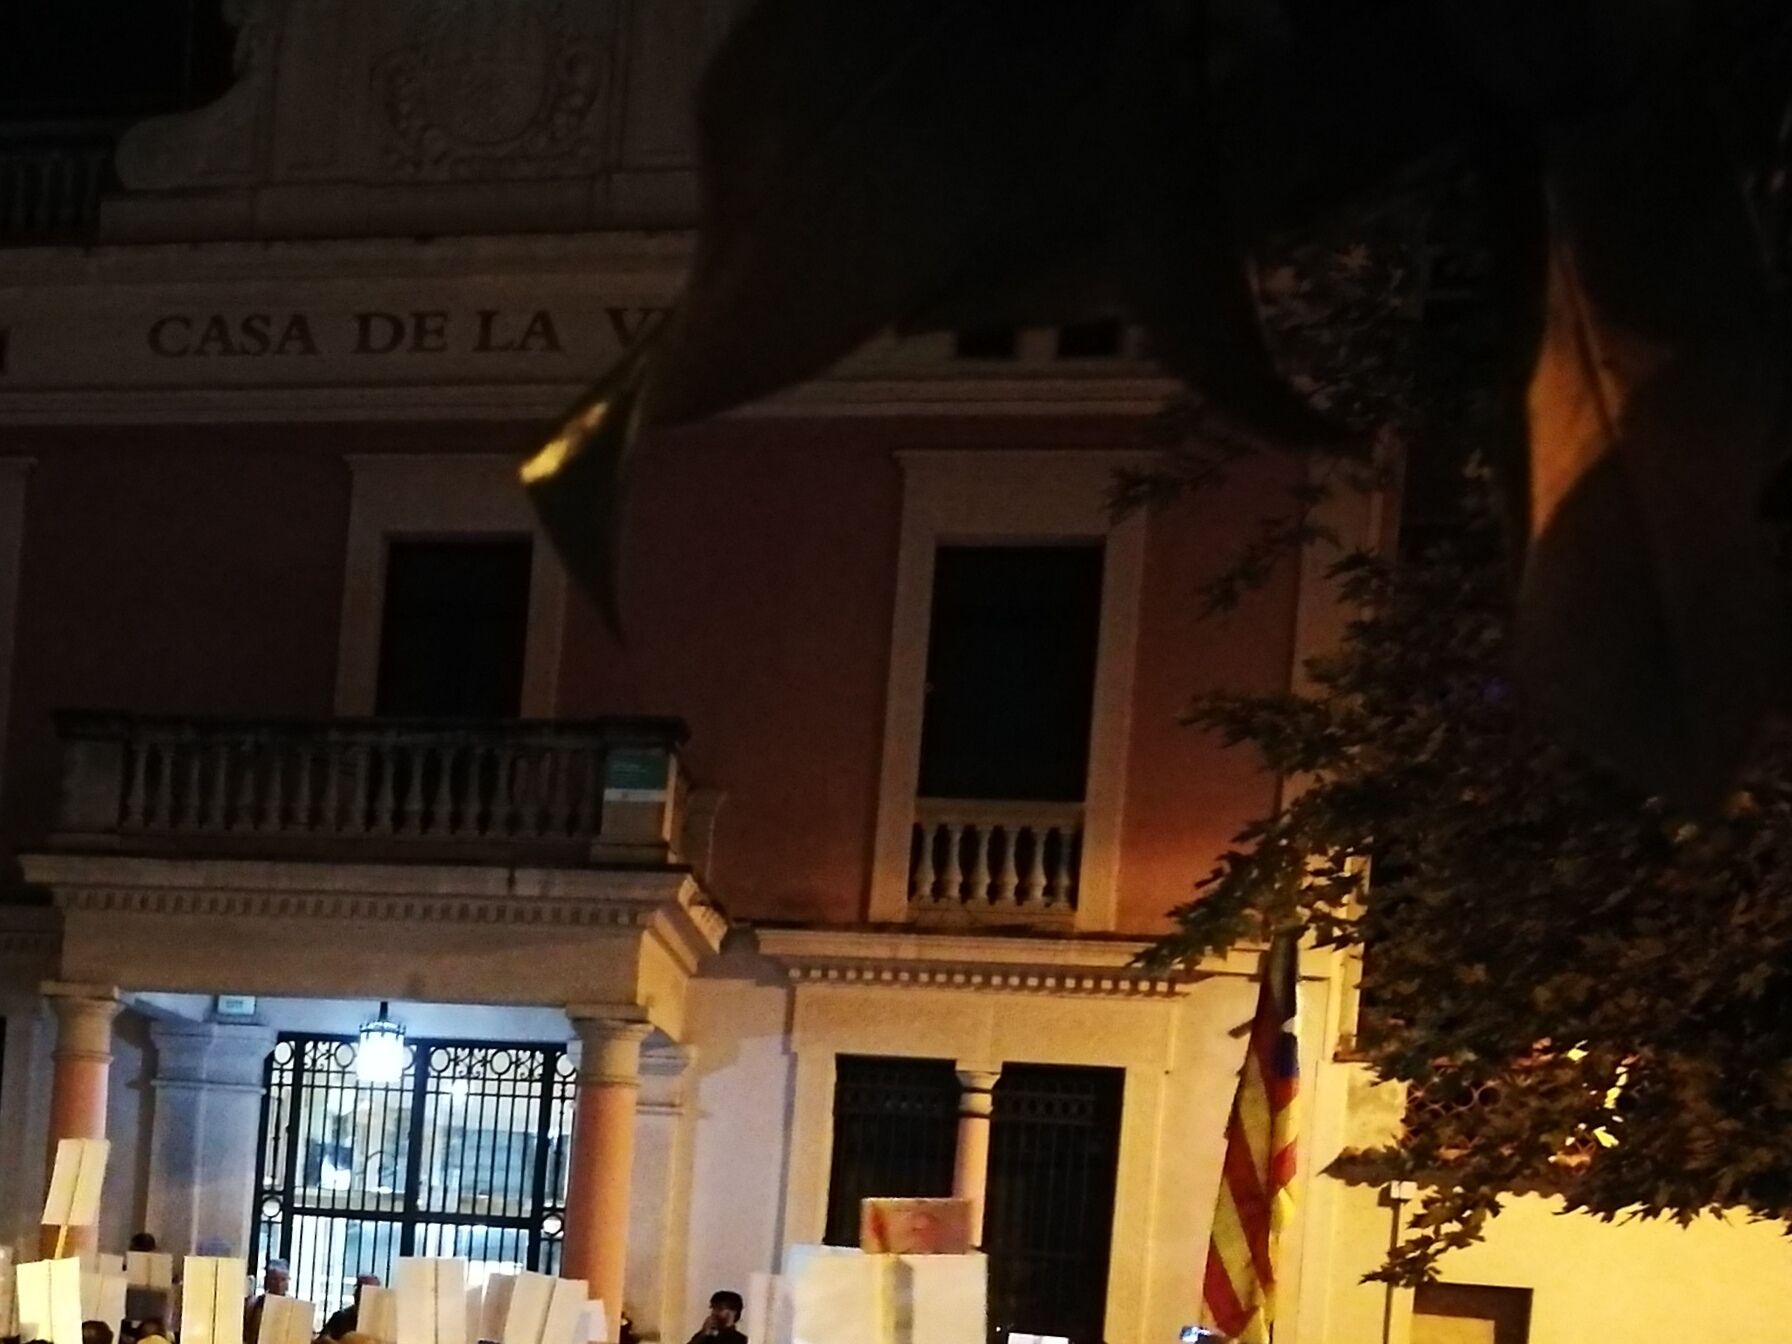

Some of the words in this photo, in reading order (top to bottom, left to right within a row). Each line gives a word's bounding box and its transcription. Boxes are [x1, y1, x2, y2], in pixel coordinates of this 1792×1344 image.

[146, 312, 321, 357] CASA
[354, 310, 449, 354] DE
[471, 308, 565, 353] LA
